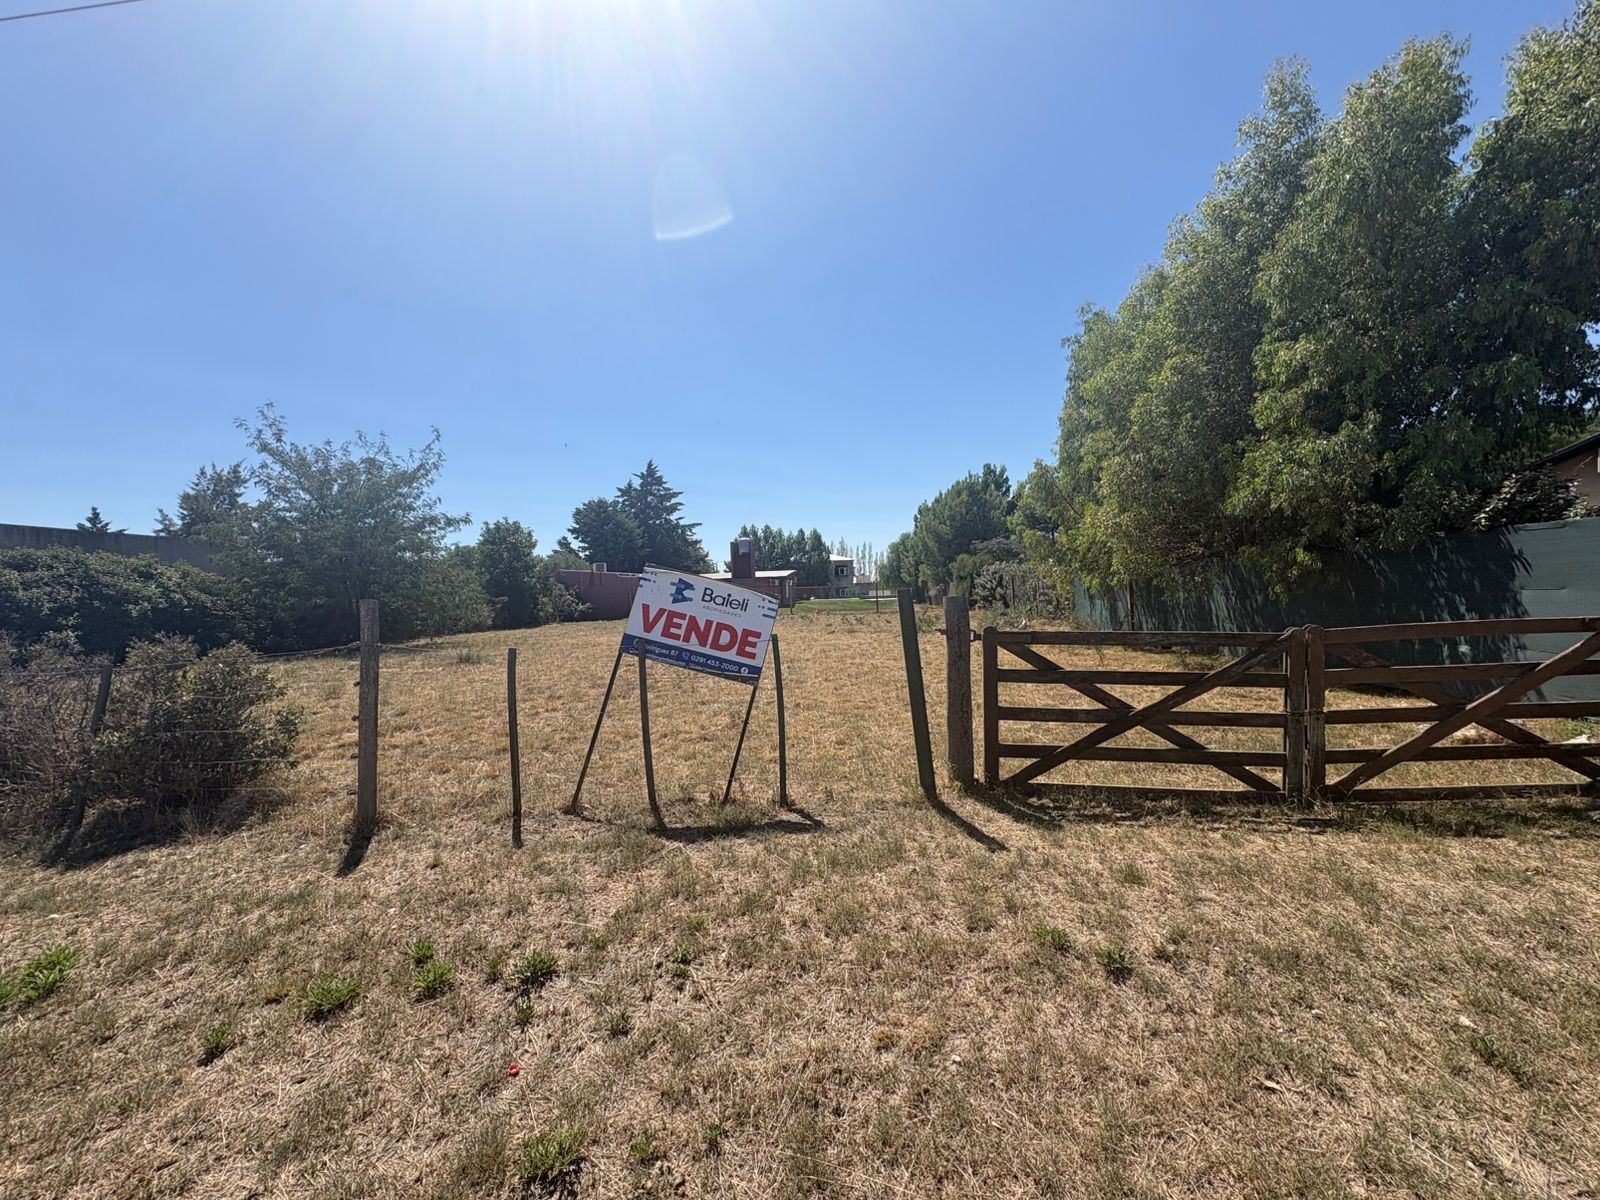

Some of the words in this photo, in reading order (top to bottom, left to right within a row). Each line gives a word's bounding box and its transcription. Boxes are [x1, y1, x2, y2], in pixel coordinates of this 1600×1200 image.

[701, 587, 749, 612] Baieli
[702, 605, 742, 618] PROPIEDADES
[642, 603, 762, 661] VENDE
[690, 655, 706, 664] 0291
[707, 659, 739, 672] 453-2000
